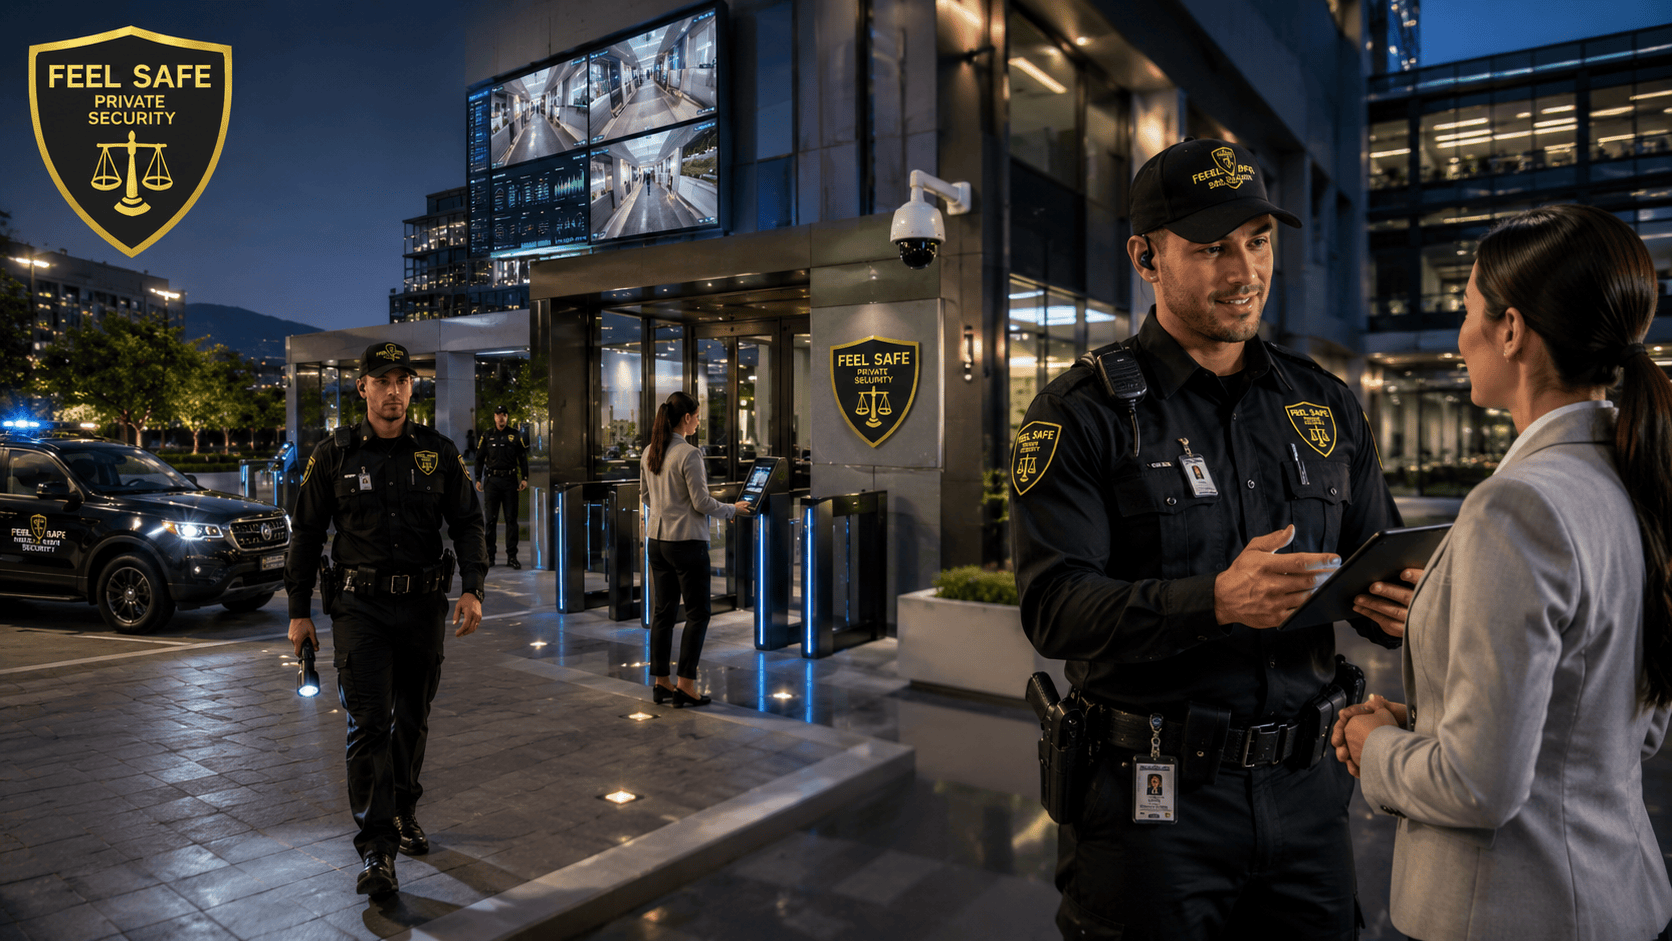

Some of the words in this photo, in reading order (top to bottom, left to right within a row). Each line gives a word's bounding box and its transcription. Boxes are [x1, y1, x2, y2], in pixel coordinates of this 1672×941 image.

[837, 353, 870, 367] FEEL
[874, 351, 910, 366] SAFE
[1032, 430, 1055, 440] SAFE
